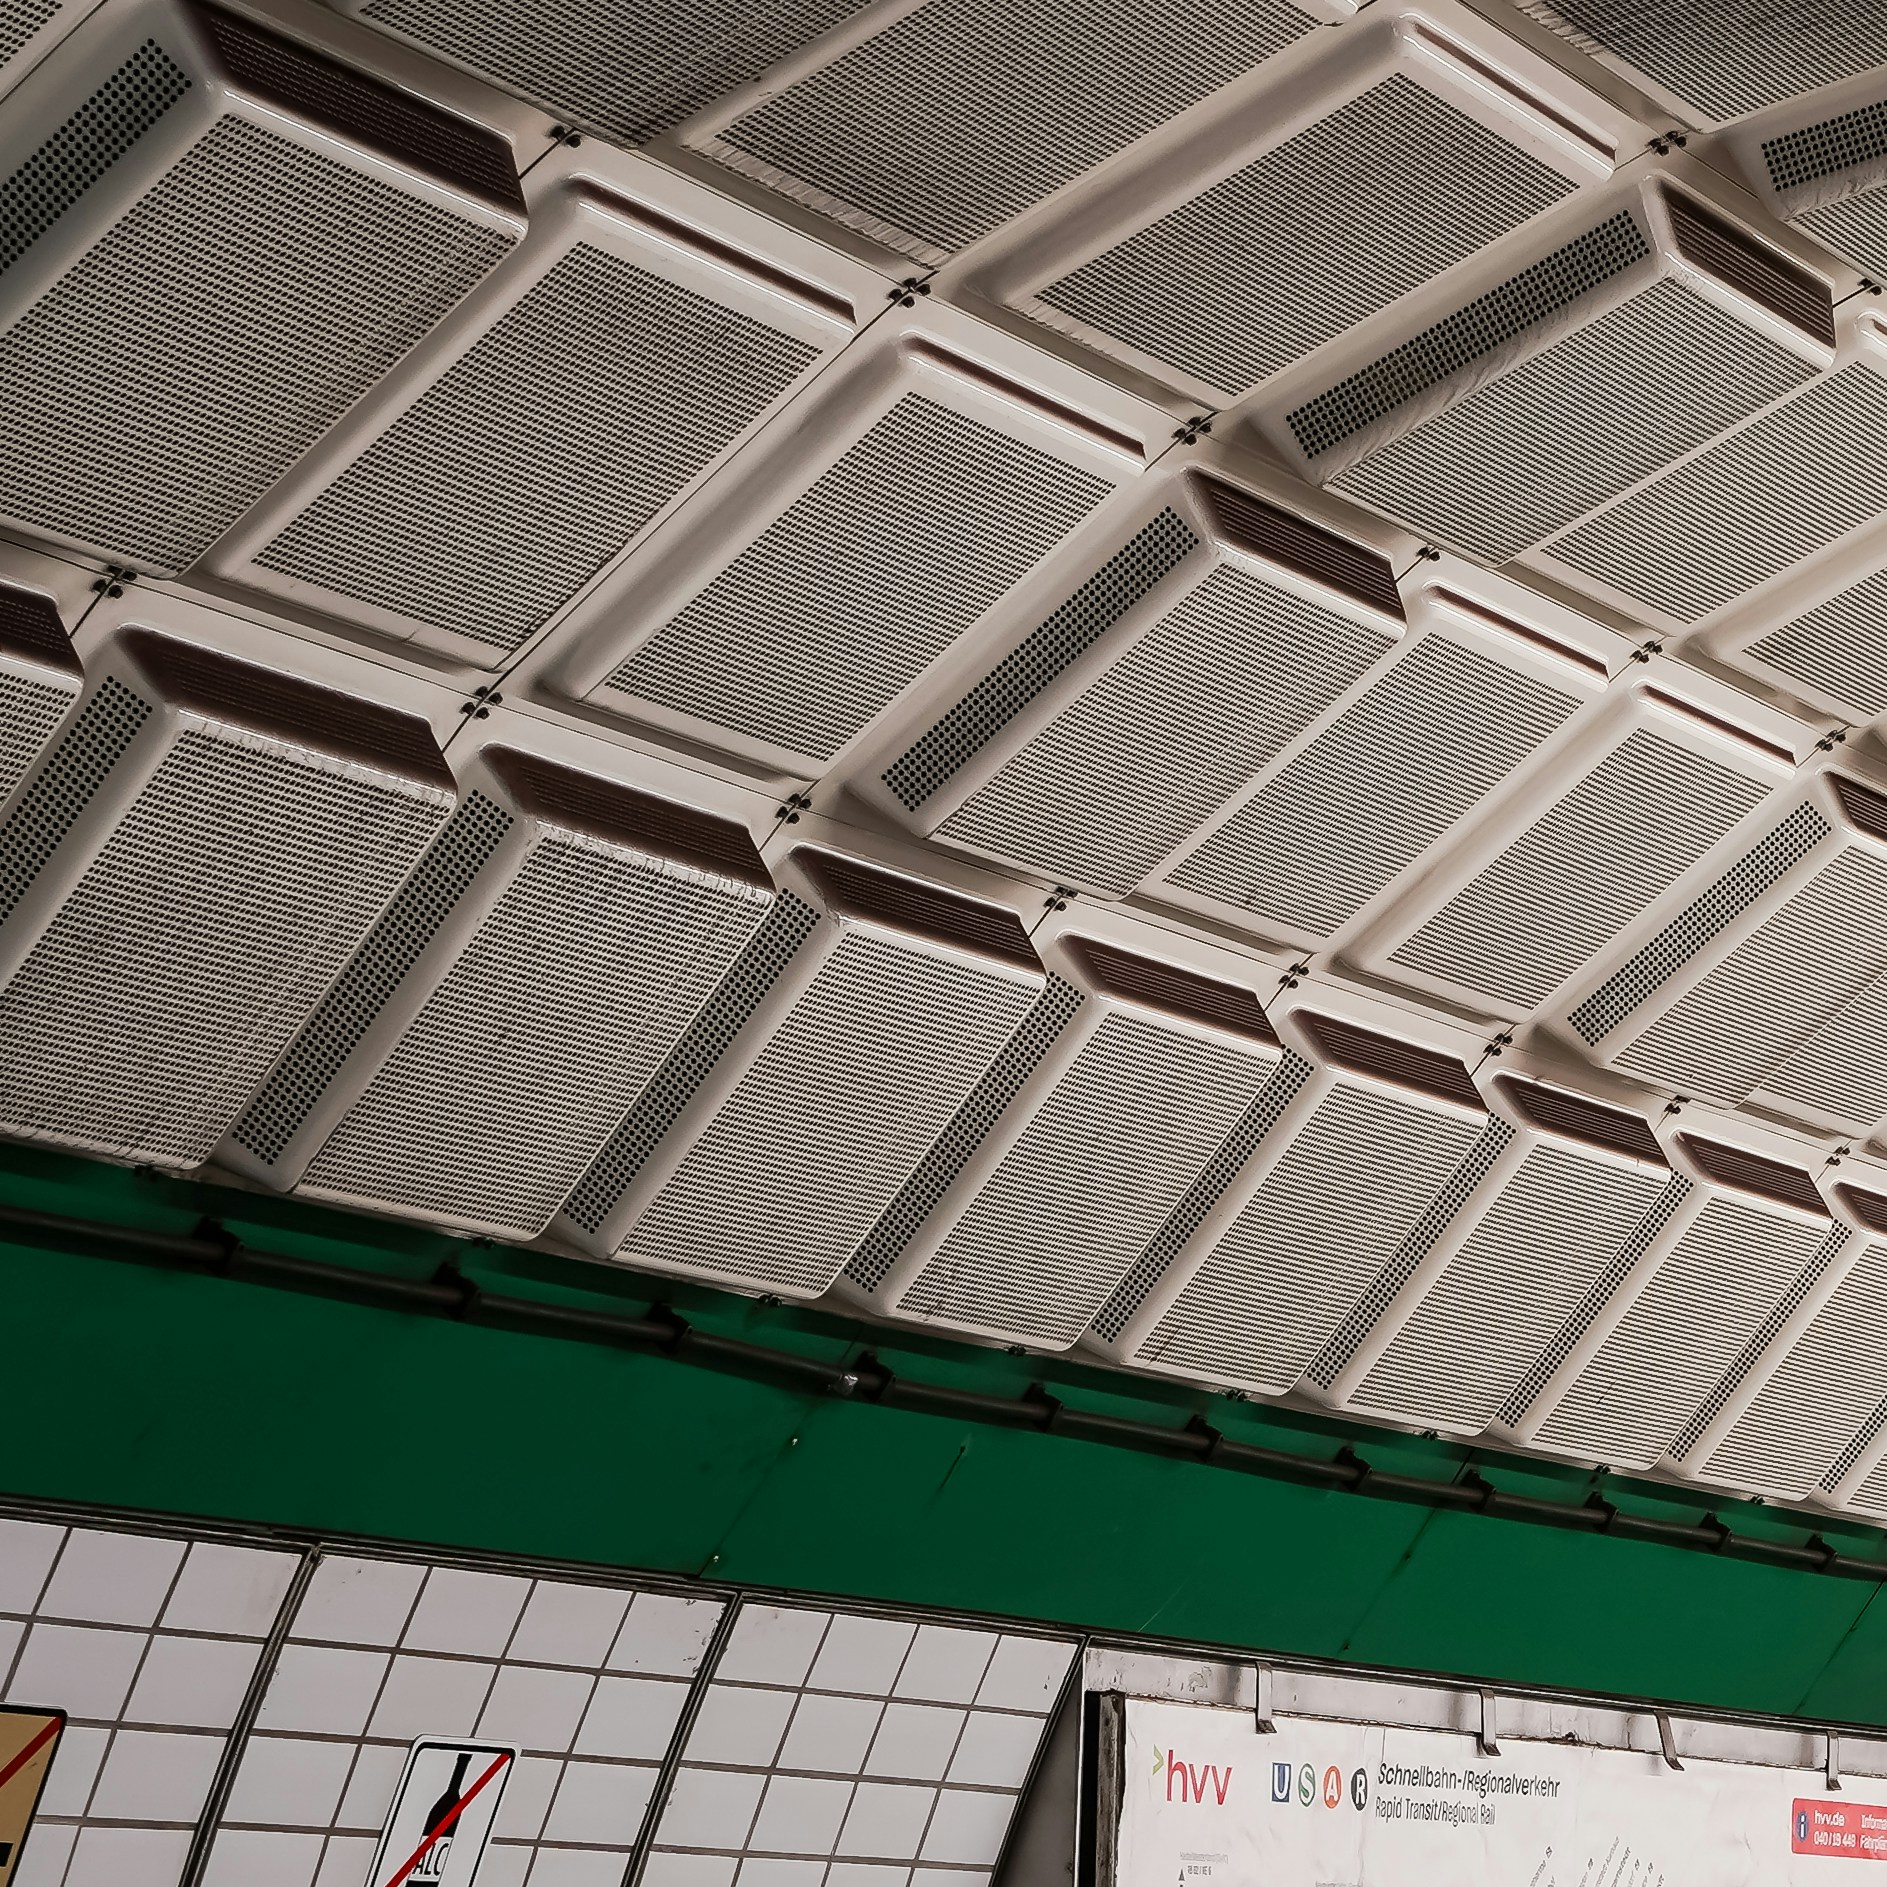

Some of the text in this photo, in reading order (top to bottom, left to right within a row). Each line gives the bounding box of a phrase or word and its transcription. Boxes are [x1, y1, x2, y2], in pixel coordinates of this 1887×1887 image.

[1167, 1749, 1233, 1805] hvv
[1377, 1762, 1561, 1799] Schnellbahn-/Regionalverkehr
[1375, 1797, 1402, 1820] Rapid
[1405, 1798, 1479, 1828] Transit/Regional
[1814, 1809, 1845, 1827] hvv.de
[411, 1842, 449, 1876] ALC
